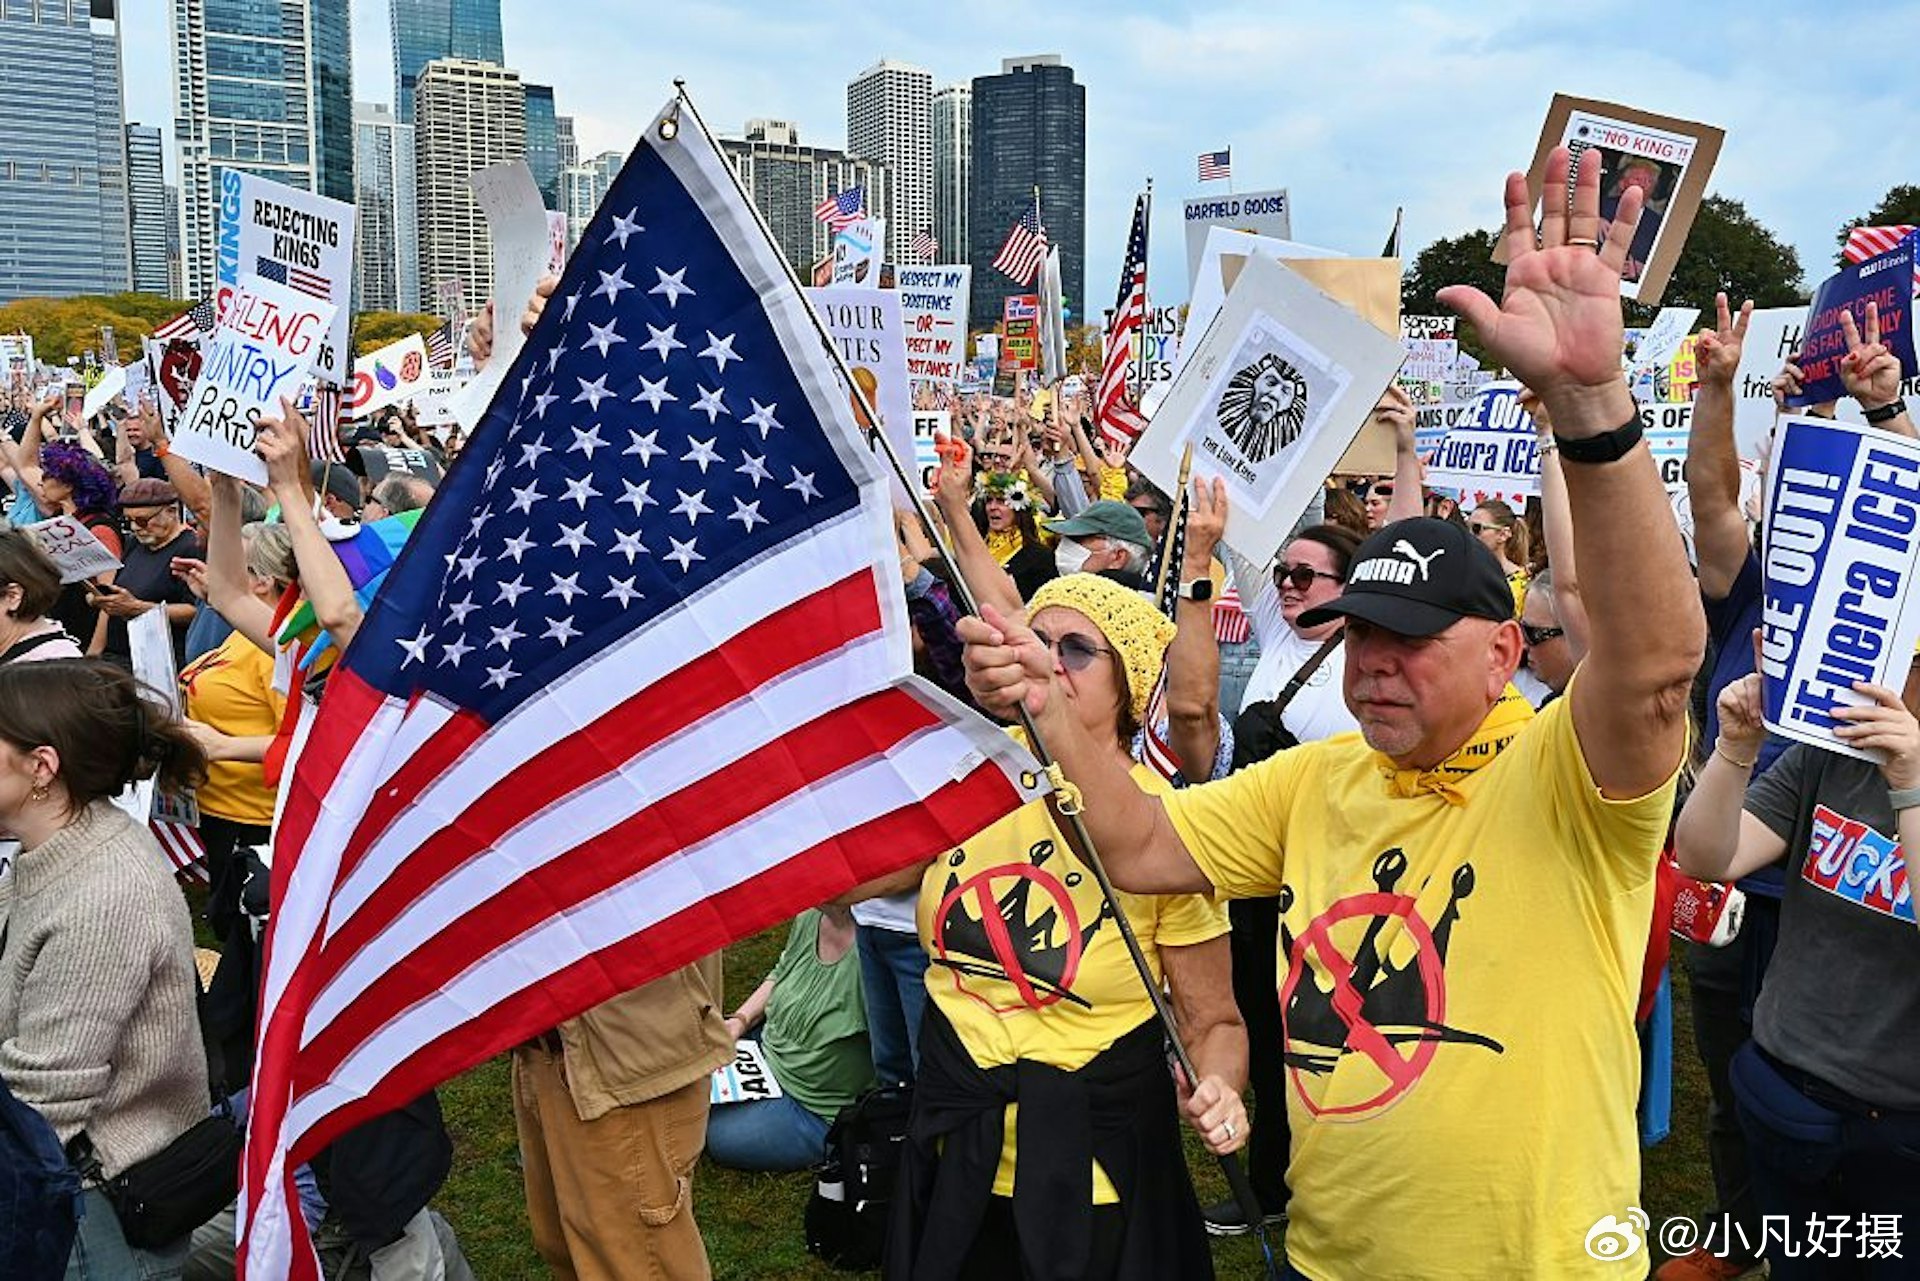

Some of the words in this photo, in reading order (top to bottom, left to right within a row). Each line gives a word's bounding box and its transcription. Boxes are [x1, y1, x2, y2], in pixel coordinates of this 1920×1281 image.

[1604, 130, 1629, 147] NO
[1633, 134, 1673, 157] KING
[1185, 201, 1240, 220] GARFIELD
[1245, 196, 1284, 215] GOOSE
[219, 171, 241, 286] KINGS
[254, 199, 338, 248] REJECTING
[273, 233, 321, 269] KINGS
[942, 272, 962, 289] MY
[826, 304, 884, 330] YOUR
[916, 314, 933, 332] OR
[1403, 316, 1450, 330] SOMOS
[1804, 360, 1832, 382] OME
[1766, 467, 1841, 587] OUT!
[1350, 558, 1417, 586] PUMA
[1761, 594, 1804, 681] ICE
[1811, 819, 1905, 900] FUCK
